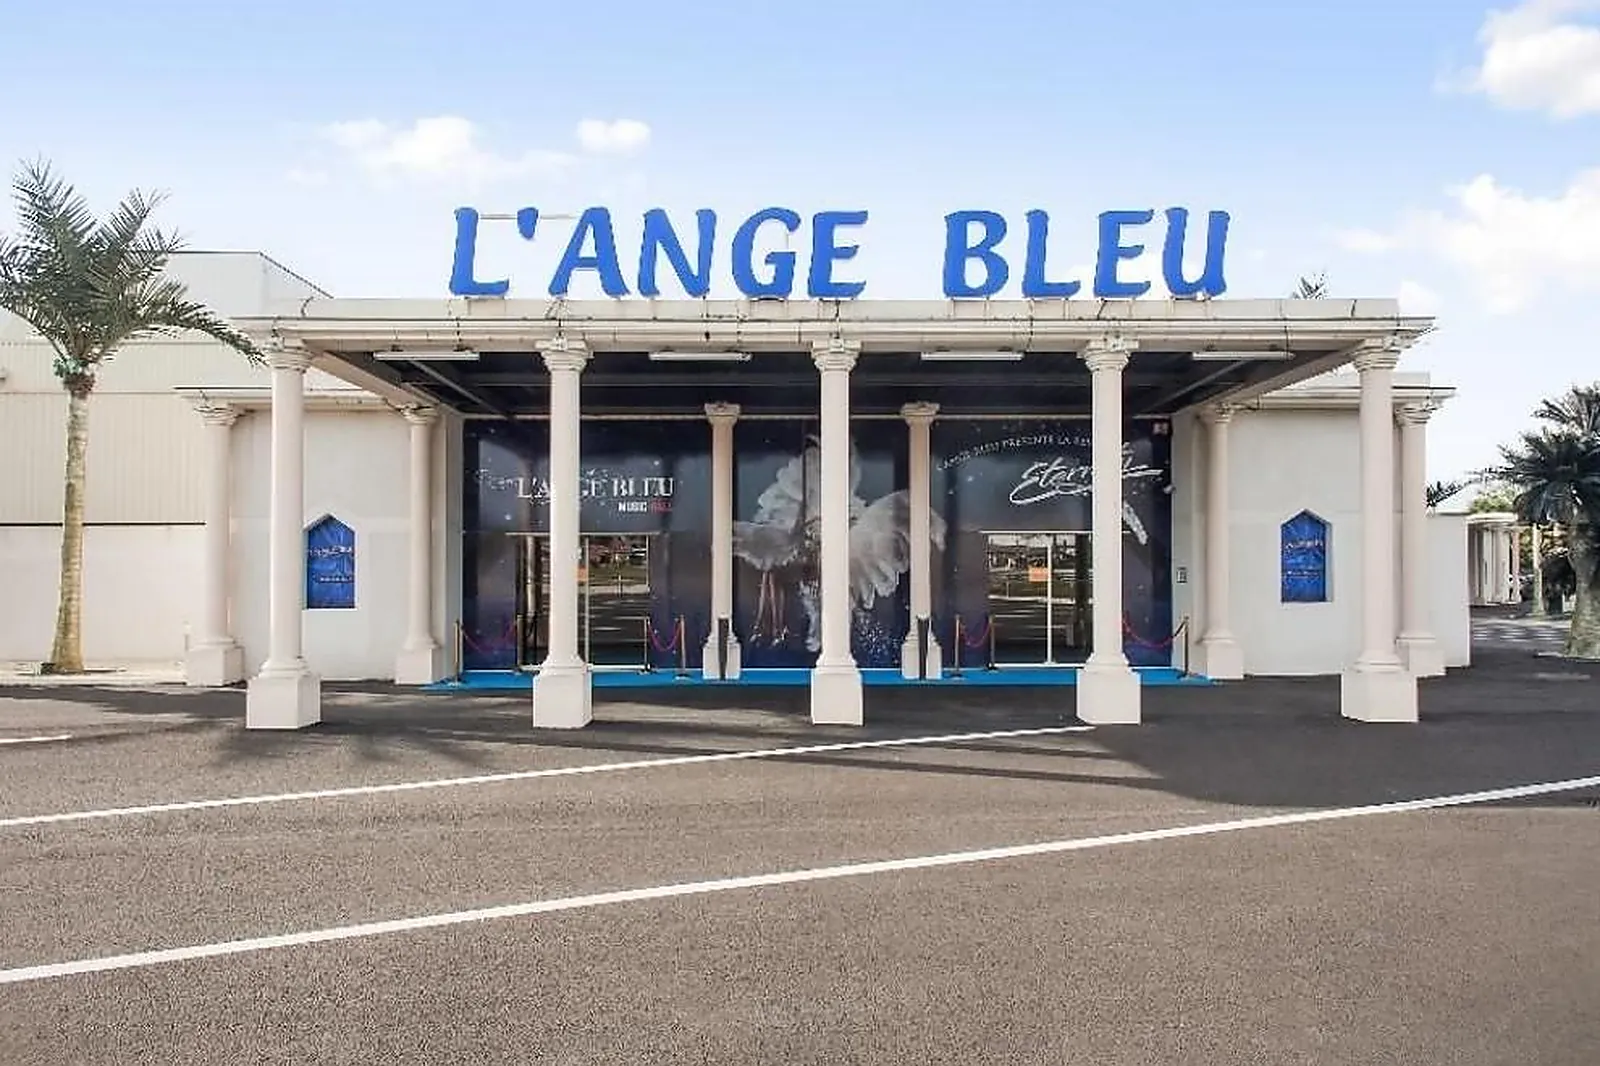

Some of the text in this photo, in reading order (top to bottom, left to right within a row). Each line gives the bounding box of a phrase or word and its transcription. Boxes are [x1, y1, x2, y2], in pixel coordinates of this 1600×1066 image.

[449, 206, 1230, 298] L'ANGE BLEU
[611, 476, 674, 497] BLEU
[618, 501, 648, 513] MUSIC
